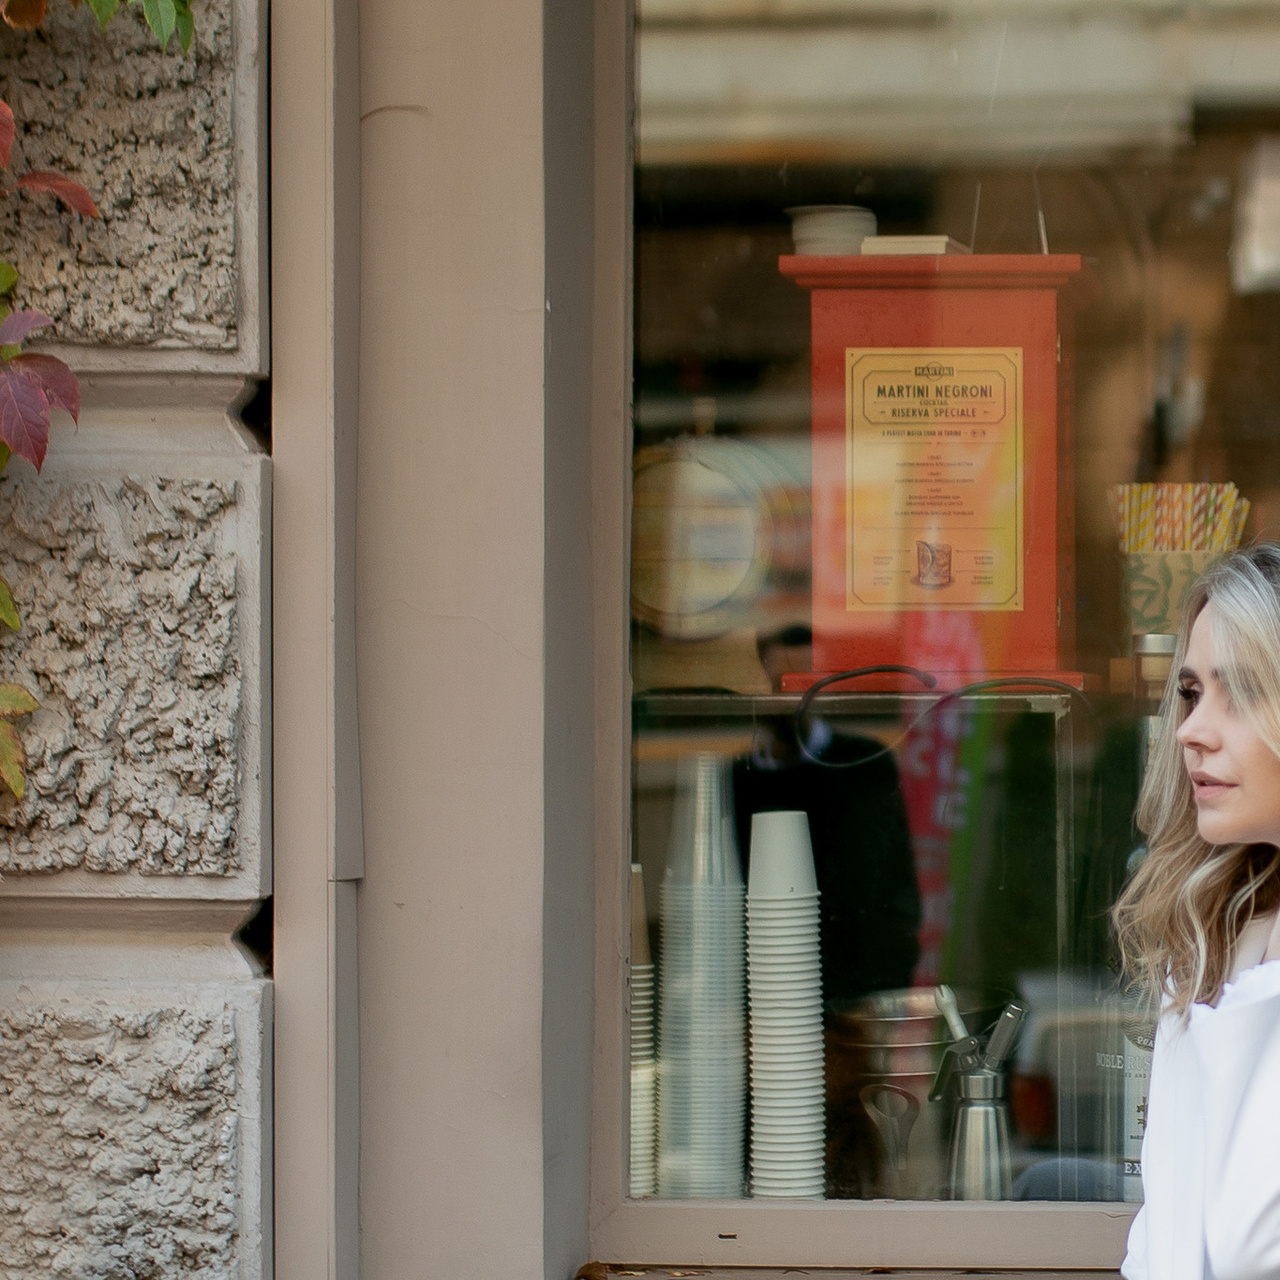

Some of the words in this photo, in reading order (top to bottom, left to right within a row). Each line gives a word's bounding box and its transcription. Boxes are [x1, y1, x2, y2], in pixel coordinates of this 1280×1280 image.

[915, 366, 954, 377] MARTINI
[877, 385, 929, 398] MARTINI
[935, 385, 993, 398] NEGRONI
[891, 408, 930, 418] RISERVA
[933, 408, 977, 418] SPECIALE
